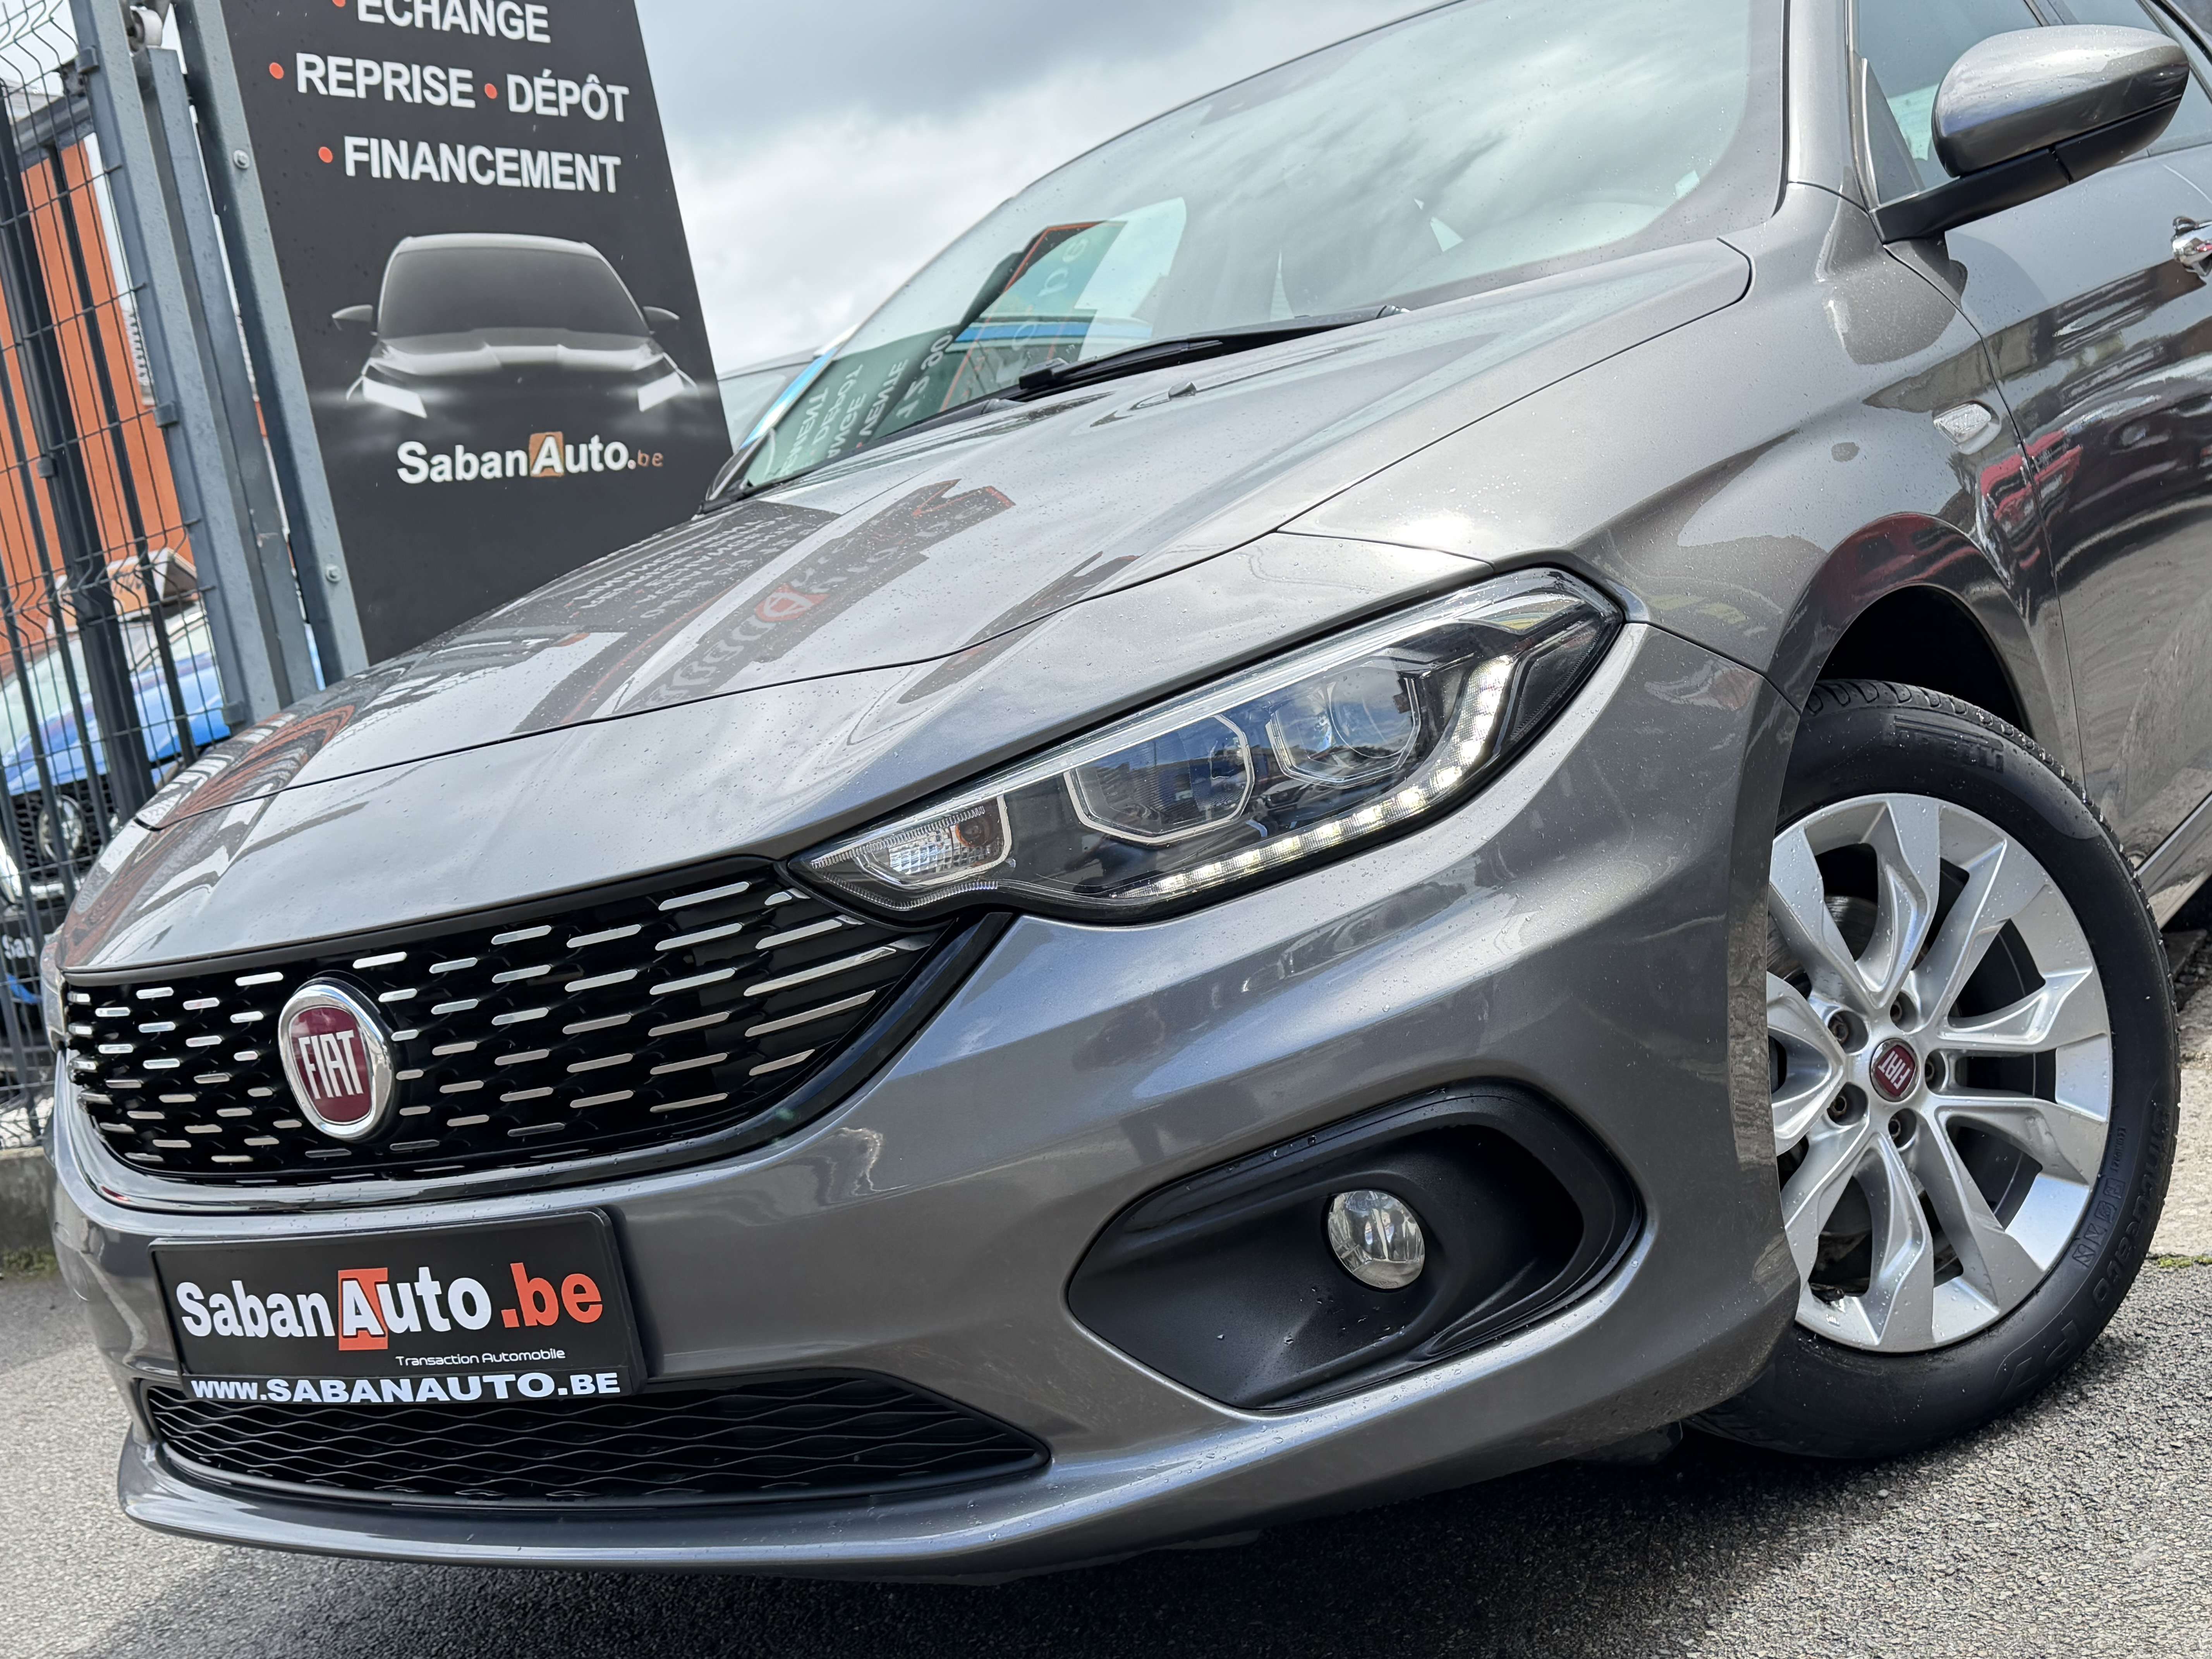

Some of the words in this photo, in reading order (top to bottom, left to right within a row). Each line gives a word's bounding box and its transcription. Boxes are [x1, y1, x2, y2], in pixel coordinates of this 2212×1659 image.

[296, 53, 476, 108] REPRISE
[507, 69, 629, 122] DÉPÔT
[344, 136, 621, 193] FINANCEMENT
[397, 434, 664, 484] SabanAuto.be
[298, 1029, 364, 1100] FIAT
[1877, 1050, 1910, 1090] FIAT
[395, 1353, 479, 1367] Transaction
[482, 1348, 566, 1363] Automobile
